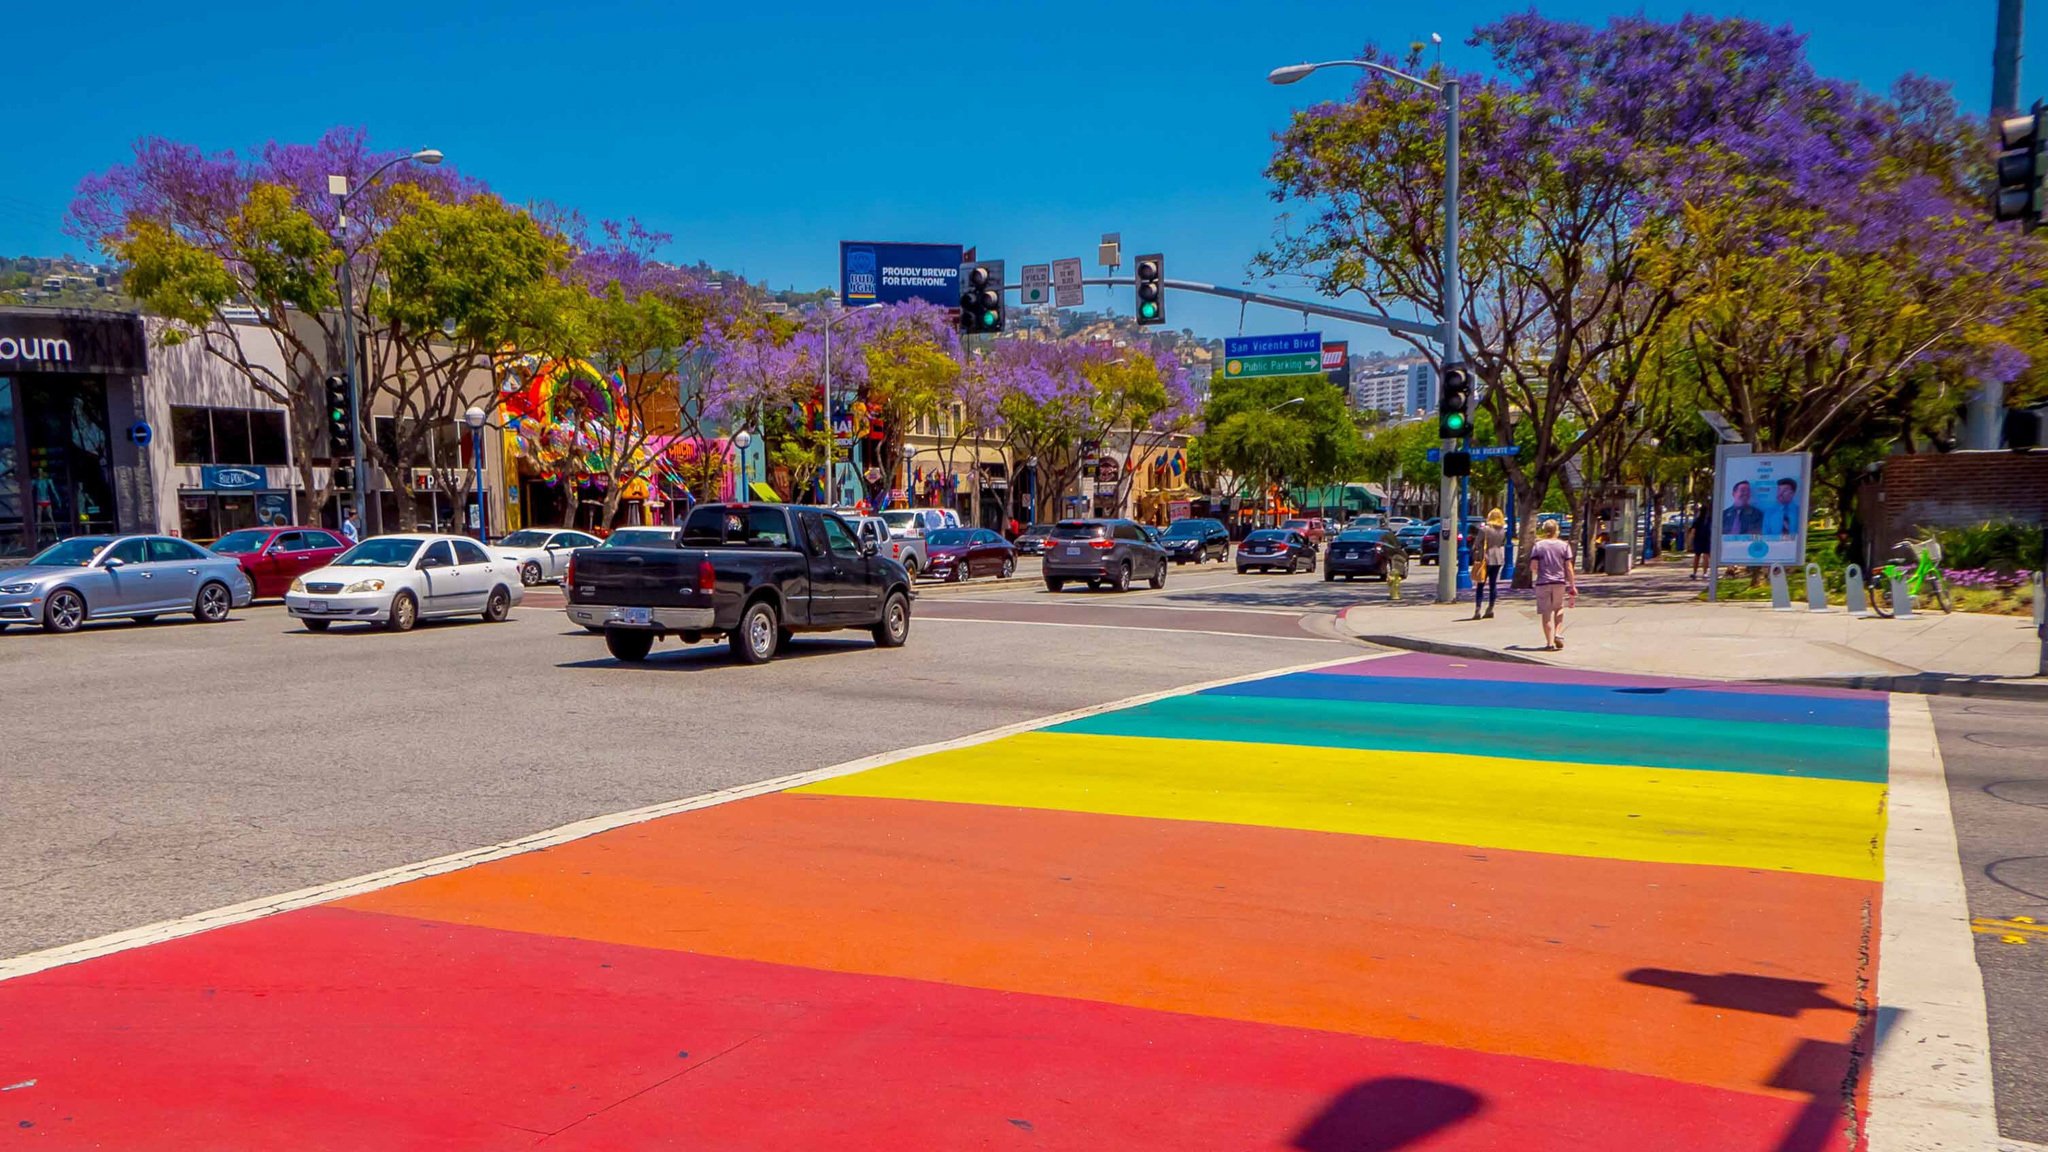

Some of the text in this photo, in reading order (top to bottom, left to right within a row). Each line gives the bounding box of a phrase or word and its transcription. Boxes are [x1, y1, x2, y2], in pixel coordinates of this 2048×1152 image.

[882, 267, 958, 277] PROUDLY BREWED
[849, 274, 875, 284] BUD
[882, 277, 947, 287] FOR EVERYONE.
[1231, 339, 1315, 352] San Vicente Blvd
[1243, 361, 1266, 372] Public
[1270, 359, 1302, 372] Parking
